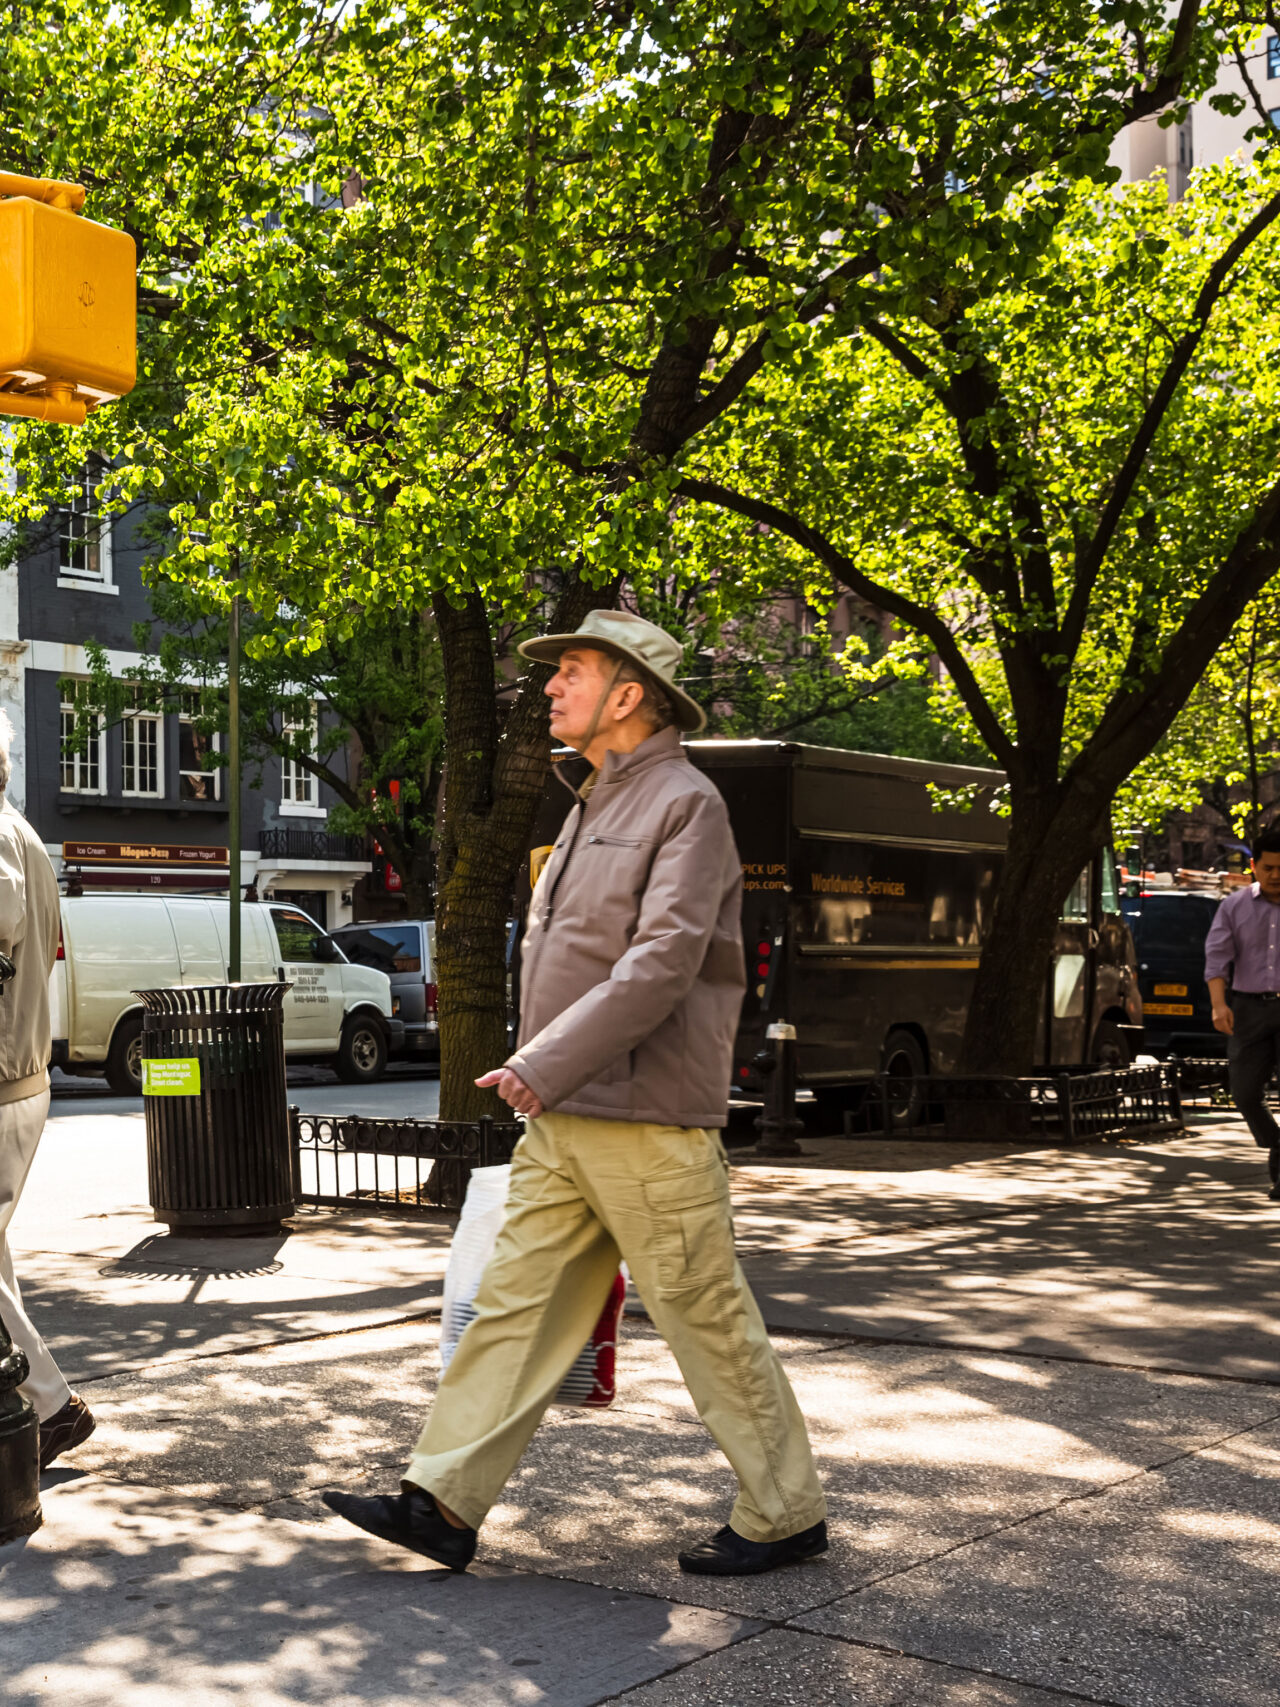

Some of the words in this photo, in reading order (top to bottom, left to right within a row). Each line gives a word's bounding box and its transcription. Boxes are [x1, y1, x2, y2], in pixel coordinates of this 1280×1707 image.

[87, 847, 107, 855] Cream
[179, 850, 198, 858] Frozen
[198, 850, 216, 859] Yogurt
[742, 864, 764, 875] PICK
[767, 864, 787, 876] UPS
[151, 876, 161, 884] 120
[743, 880, 785, 891] ups.com
[811, 873, 863, 894] Worldwide
[867, 876, 906, 896] Services
